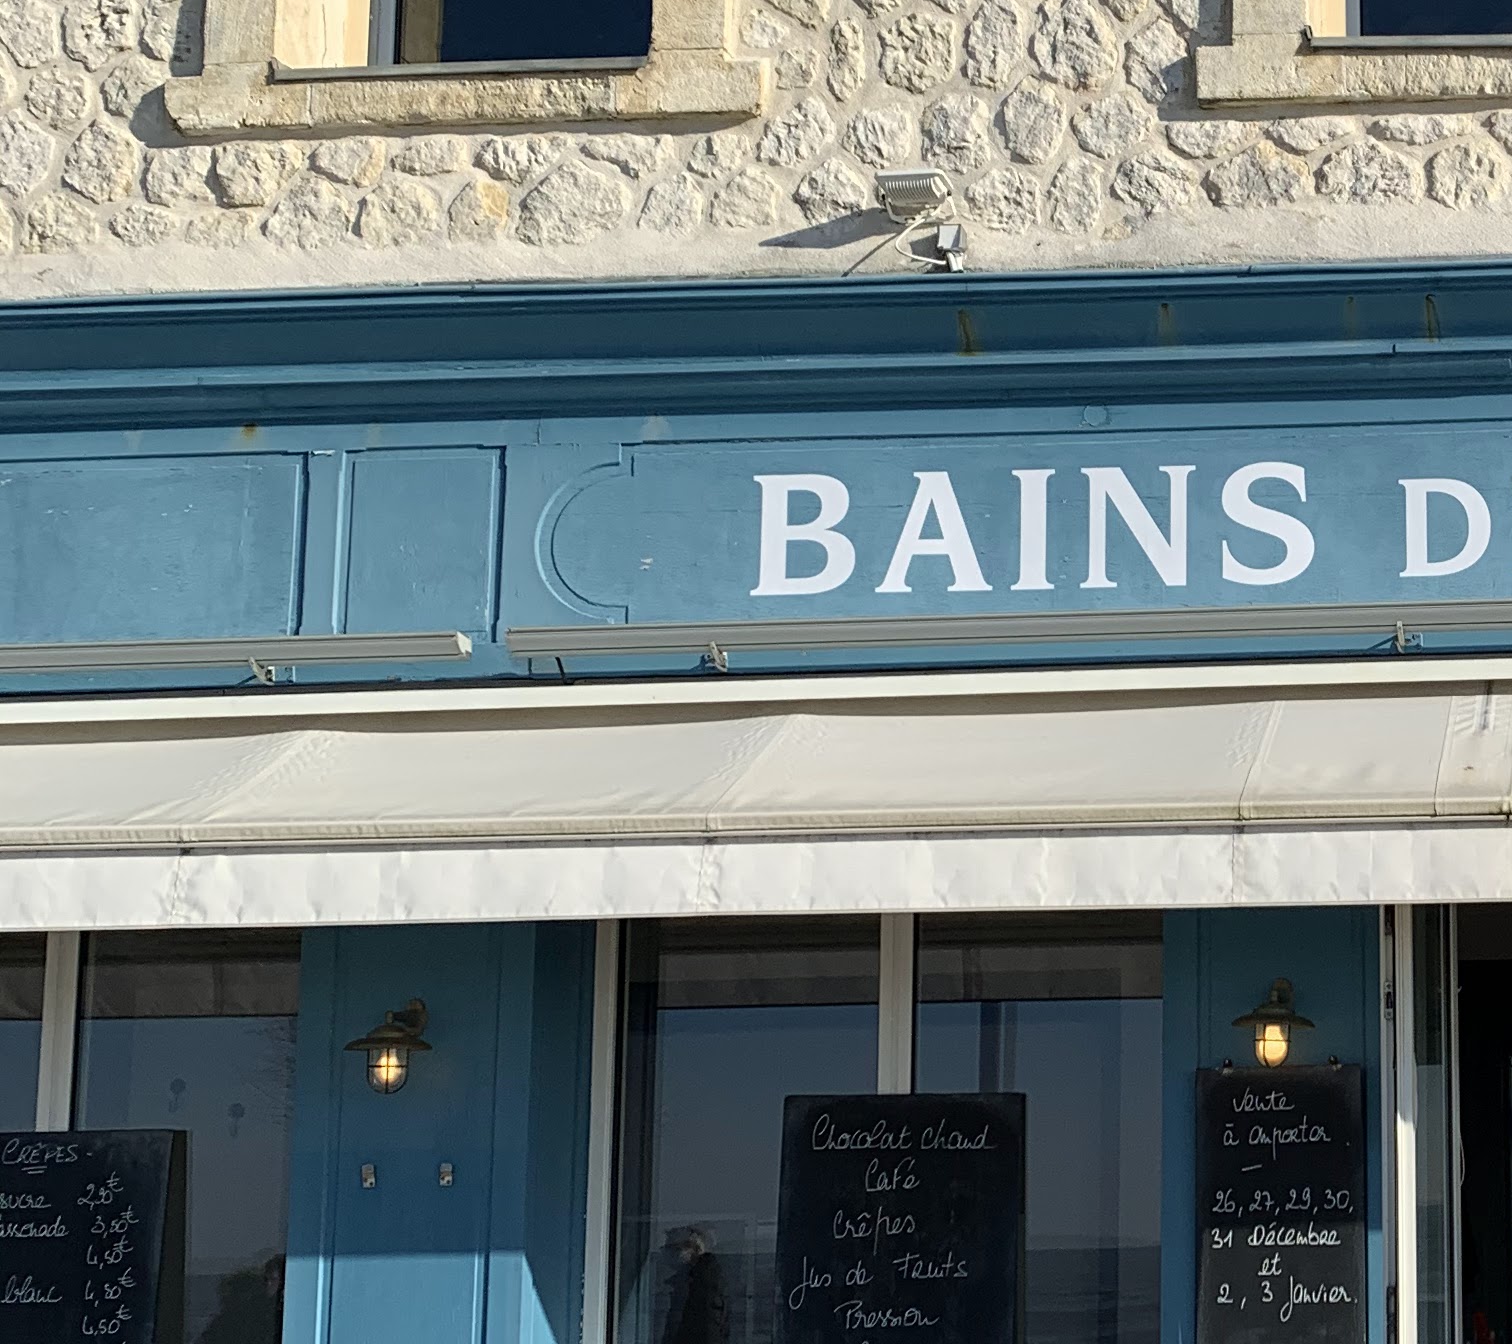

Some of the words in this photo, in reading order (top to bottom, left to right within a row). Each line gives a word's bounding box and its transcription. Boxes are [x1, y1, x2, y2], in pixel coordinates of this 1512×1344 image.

[749, 460, 1317, 597] BAINS
[812, 1113, 912, 1151] Chocolat
[864, 1157, 920, 1193] Café
[0, 1213, 69, 1238] assonade
[1211, 1227, 1233, 1249] 31
[1258, 1252, 1282, 1276] et
[789, 1256, 831, 1310] Jus
[845, 1260, 874, 1286] de
[1260, 1280, 1274, 1303] 3
[833, 1300, 940, 1330] Pression
